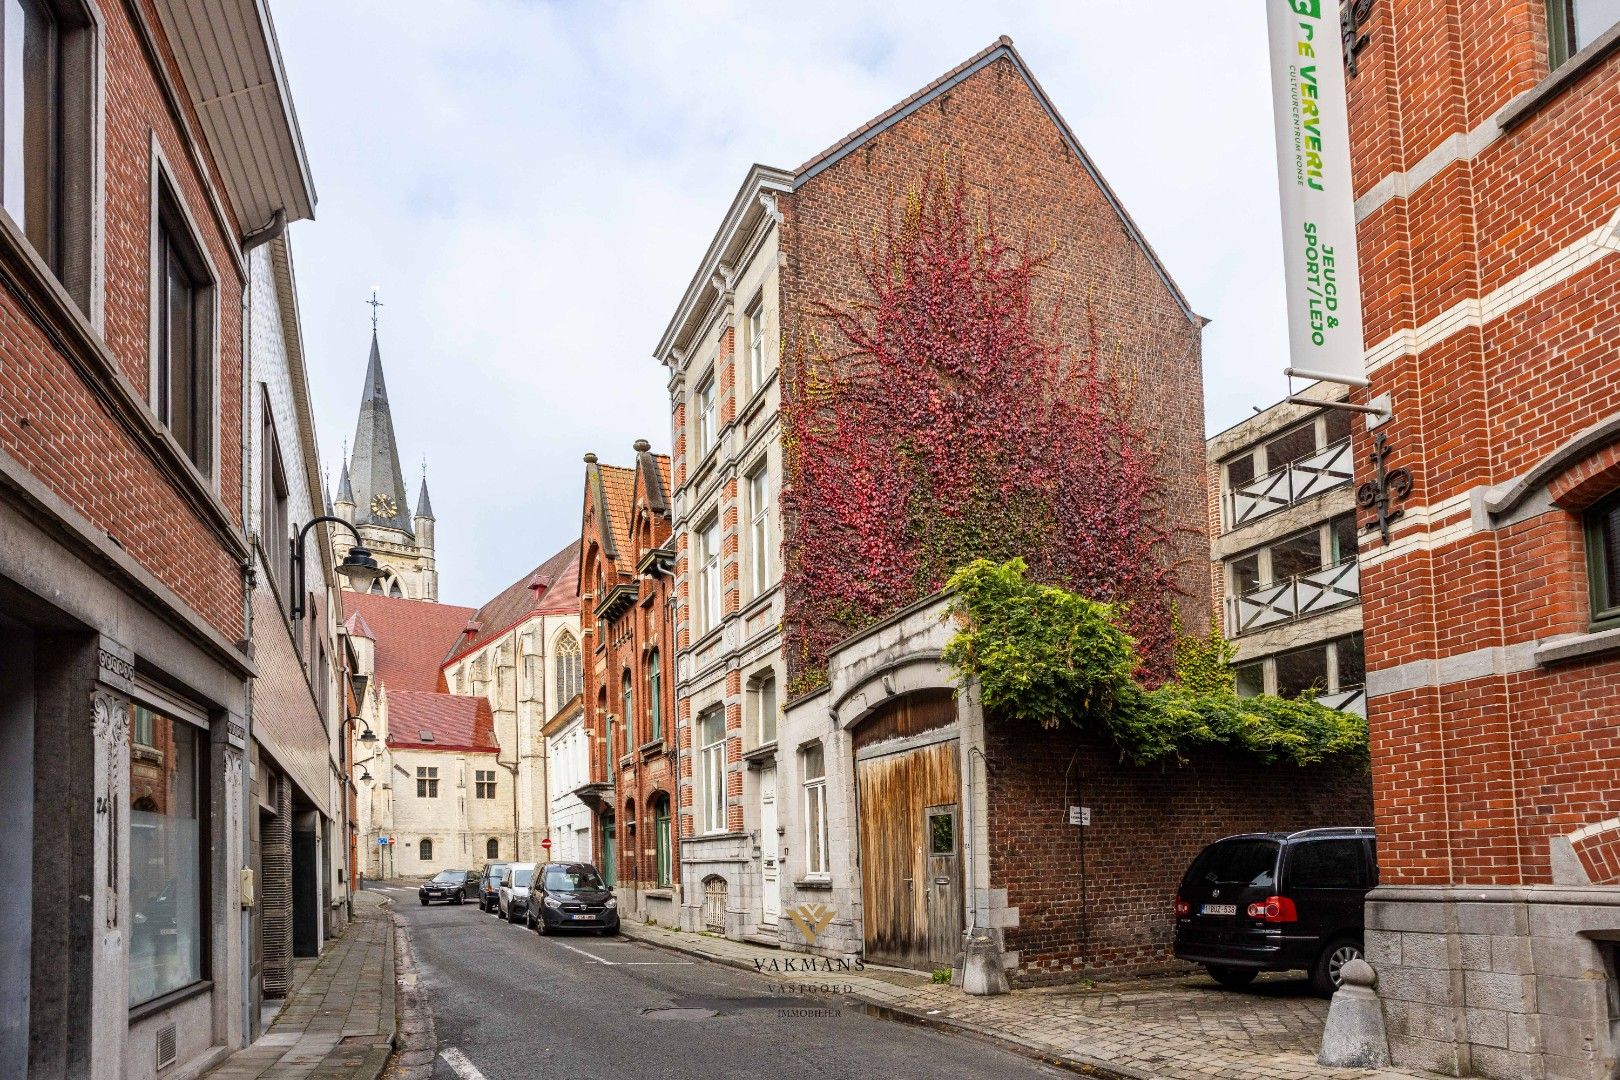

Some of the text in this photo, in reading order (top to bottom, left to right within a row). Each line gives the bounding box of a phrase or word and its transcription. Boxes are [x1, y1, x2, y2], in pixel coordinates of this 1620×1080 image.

[1289, 65, 1304, 187] CULTUURCENTRUM RONSE
[1300, 66, 1324, 191] VERVERIJ
[1322, 243, 1339, 329] JEUGD &
